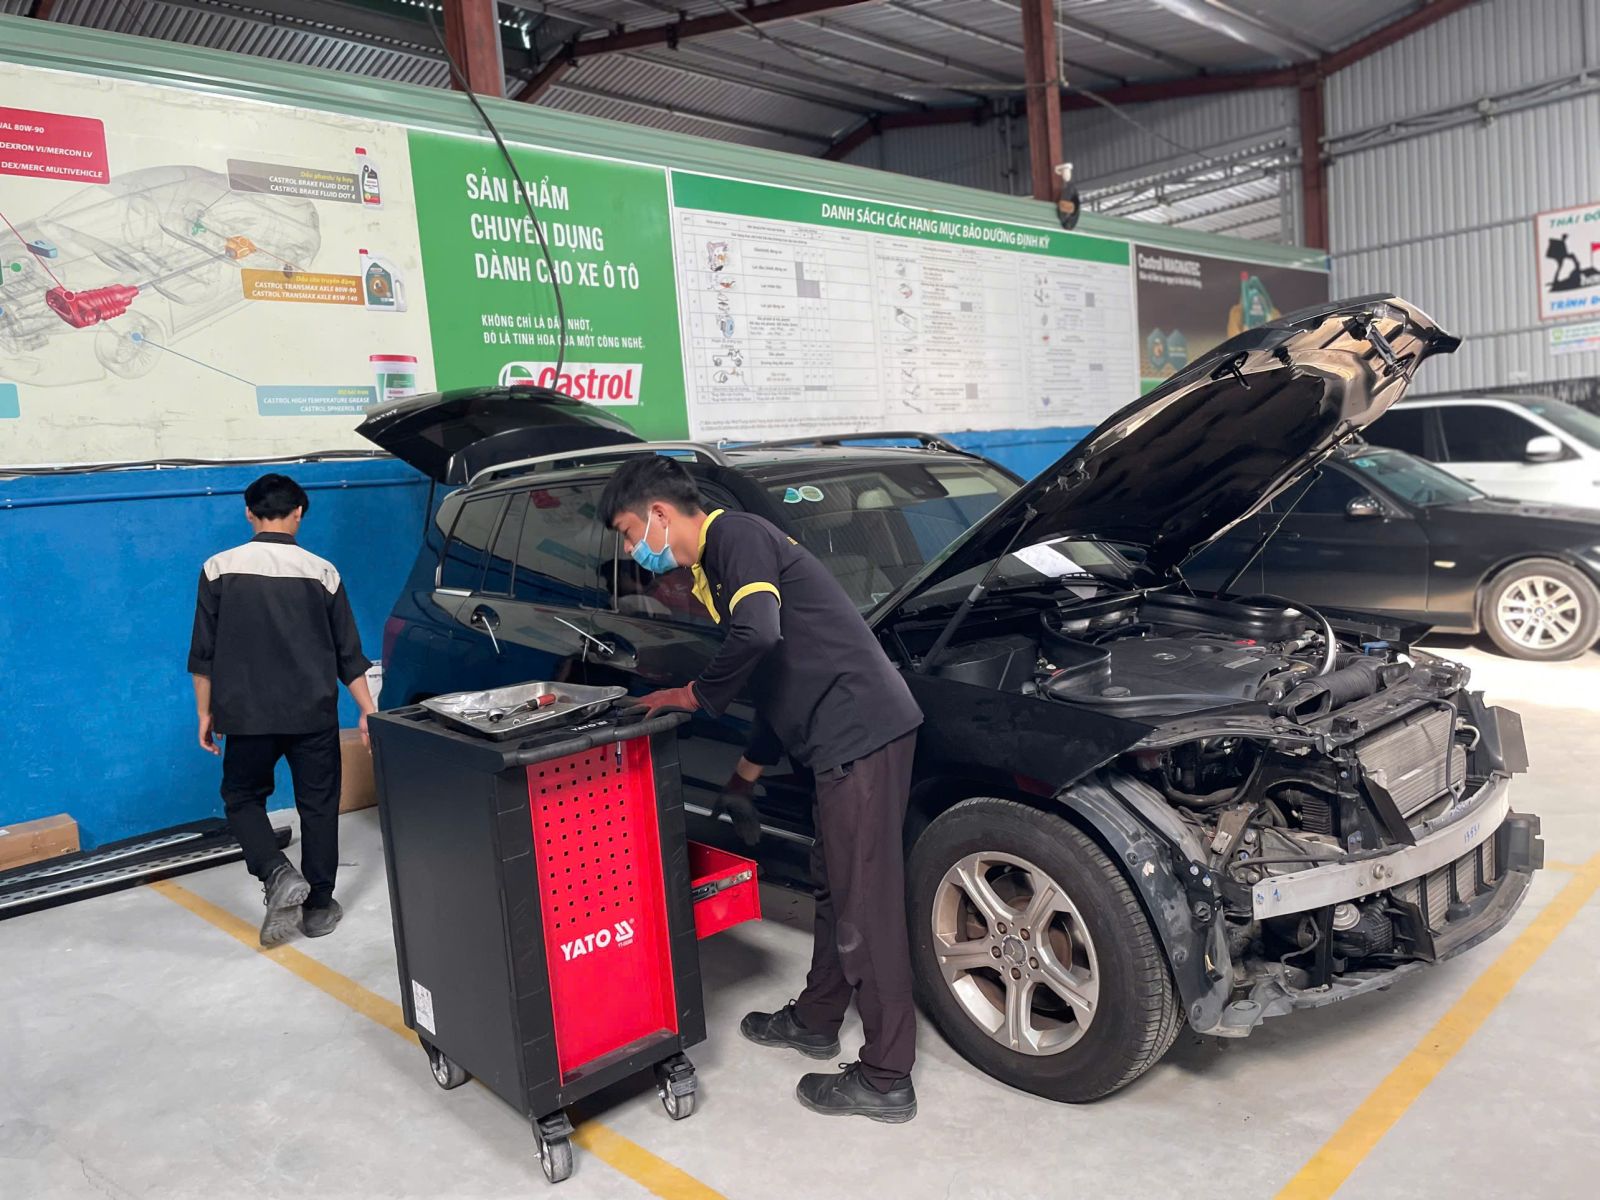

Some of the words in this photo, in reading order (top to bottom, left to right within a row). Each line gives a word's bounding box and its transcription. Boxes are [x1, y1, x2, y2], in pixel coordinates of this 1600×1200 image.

[14, 124, 45, 134] 80W-90
[0, 141, 34, 152] DEXRON
[36, 145, 82, 157] VI/MERCON
[1, 161, 45, 172] DEX/MERC
[45, 166, 103, 178] MULTIVEHICLE
[269, 176, 297, 185] CASTROL
[298, 179, 318, 188] BRAKE
[319, 181, 336, 189] FLUID
[337, 183, 350, 191] DOT
[270, 184, 298, 194] CASTROL
[299, 187, 319, 196] BRAKE
[320, 190, 337, 198] FLUID
[465, 167, 509, 203] SẢN
[513, 175, 569, 211] PHẨM
[470, 213, 549, 246] CHUYÊN
[552, 222, 604, 253] DỤNG
[821, 203, 854, 221] DANH
[856, 207, 886, 227] SÁCH
[886, 211, 907, 230] CÁC
[908, 217, 938, 235] HẠNG
[939, 221, 962, 240] MỤC
[962, 222, 981, 240] BẢO
[982, 227, 1016, 245] DƯỠNG
[1016, 232, 1038, 249] ĐỊNH
[474, 248, 532, 282] DÀNH
[535, 258, 573, 285] CHO
[576, 262, 600, 287] XE
[603, 260, 615, 288] Ô
[616, 262, 639, 290] TÔ
[252, 290, 283, 298] CASTROL
[284, 291, 316, 299] TRANSMAX
[255, 281, 283, 290] CASTROL
[284, 283, 319, 291] TRANSMAX
[481, 313, 514, 328] KHÔNG
[516, 313, 532, 328] CHỈ
[534, 314, 545, 329] LÀ
[483, 329, 497, 344] ĐÓ
[499, 330, 511, 344] LÀ
[512, 332, 535, 345] TINH
[537, 333, 556, 346] HOA
[576, 334, 595, 348] MỘT
[597, 334, 620, 348] CÔNG
[538, 367, 632, 400] Castrol
[560, 929, 611, 961] YATO
